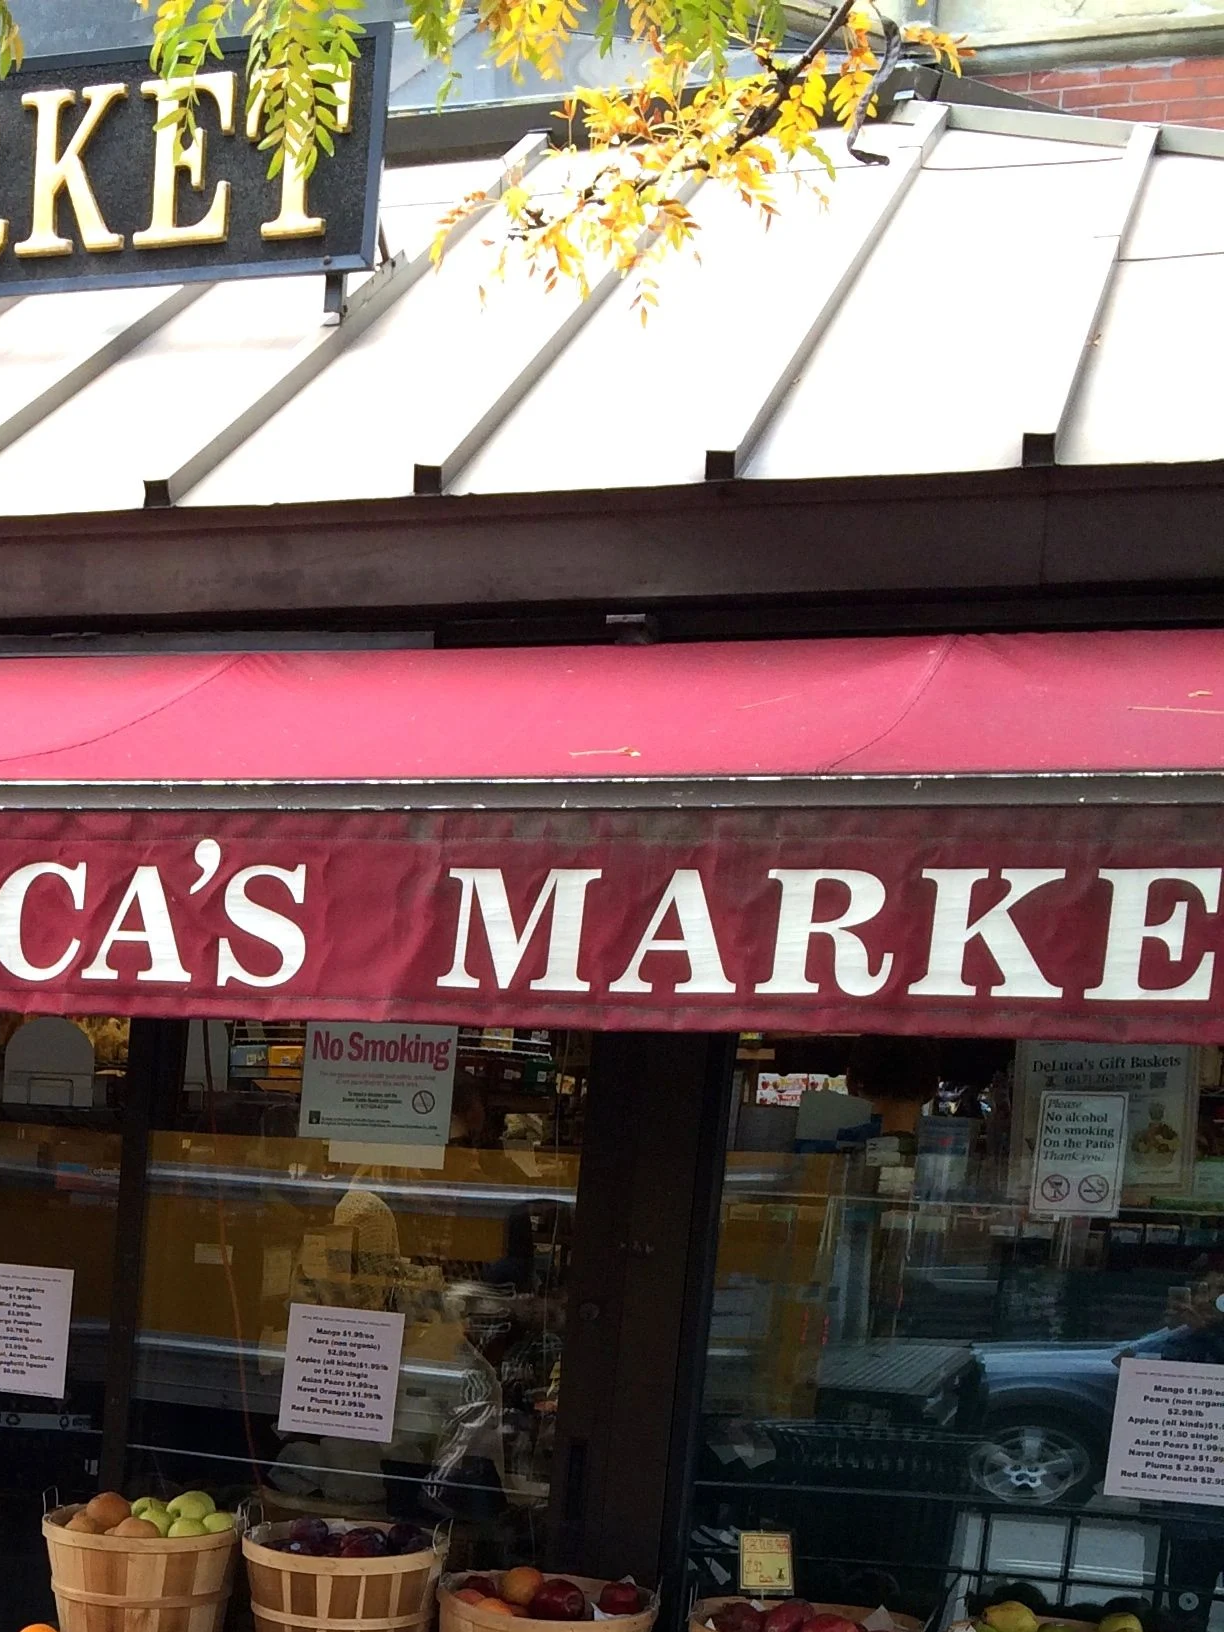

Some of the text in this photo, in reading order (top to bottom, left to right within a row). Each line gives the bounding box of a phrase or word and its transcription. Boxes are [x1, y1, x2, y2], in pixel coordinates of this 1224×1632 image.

[436, 867, 1223, 1001] MARKE
[313, 1031, 452, 1071] No Smoking
[1032, 1054, 1182, 1072] DeLuca's Gift Baskets
[1047, 1099, 1082, 1109] Please
[1046, 1112, 1108, 1123] No alcohol
[1044, 1125, 1115, 1138] No smoking
[1043, 1138, 1115, 1149] On the Patio
[1043, 1151, 1078, 1161] Thank
[316, 1327, 341, 1337] Mango
[308, 1337, 329, 1345] Pears
[349, 1341, 381, 1351] organic)
[296, 1355, 321, 1364] Apples
[323, 1357, 335, 1366] (all
[323, 1368, 344, 1376] $1.50
[345, 1370, 369, 1379] single
[301, 1376, 322, 1384] Asian
[296, 1385, 318, 1393] Navel
[319, 1387, 350, 1397] Oranges
[1153, 1385, 1184, 1394] Mango
[1143, 1395, 1170, 1404] Pears
[1172, 1397, 1193, 1406] (non
[291, 1404, 305, 1412] Red
[322, 1408, 352, 1417] Peanuts
[1127, 1416, 1159, 1425] Apples
[1161, 1418, 1177, 1427] (all
[1162, 1429, 1188, 1438] $1.50
[1190, 1432, 1219, 1441] single
[1134, 1438, 1161, 1447] Asian
[1163, 1440, 1189, 1450] Pears
[1128, 1448, 1155, 1458] Navel
[1156, 1451, 1196, 1462] Oranges
[1145, 1461, 1173, 1470] Plums
[1120, 1470, 1138, 1478] Red
[1140, 1472, 1157, 1480] Sox
[1160, 1473, 1198, 1483] Peanuts
